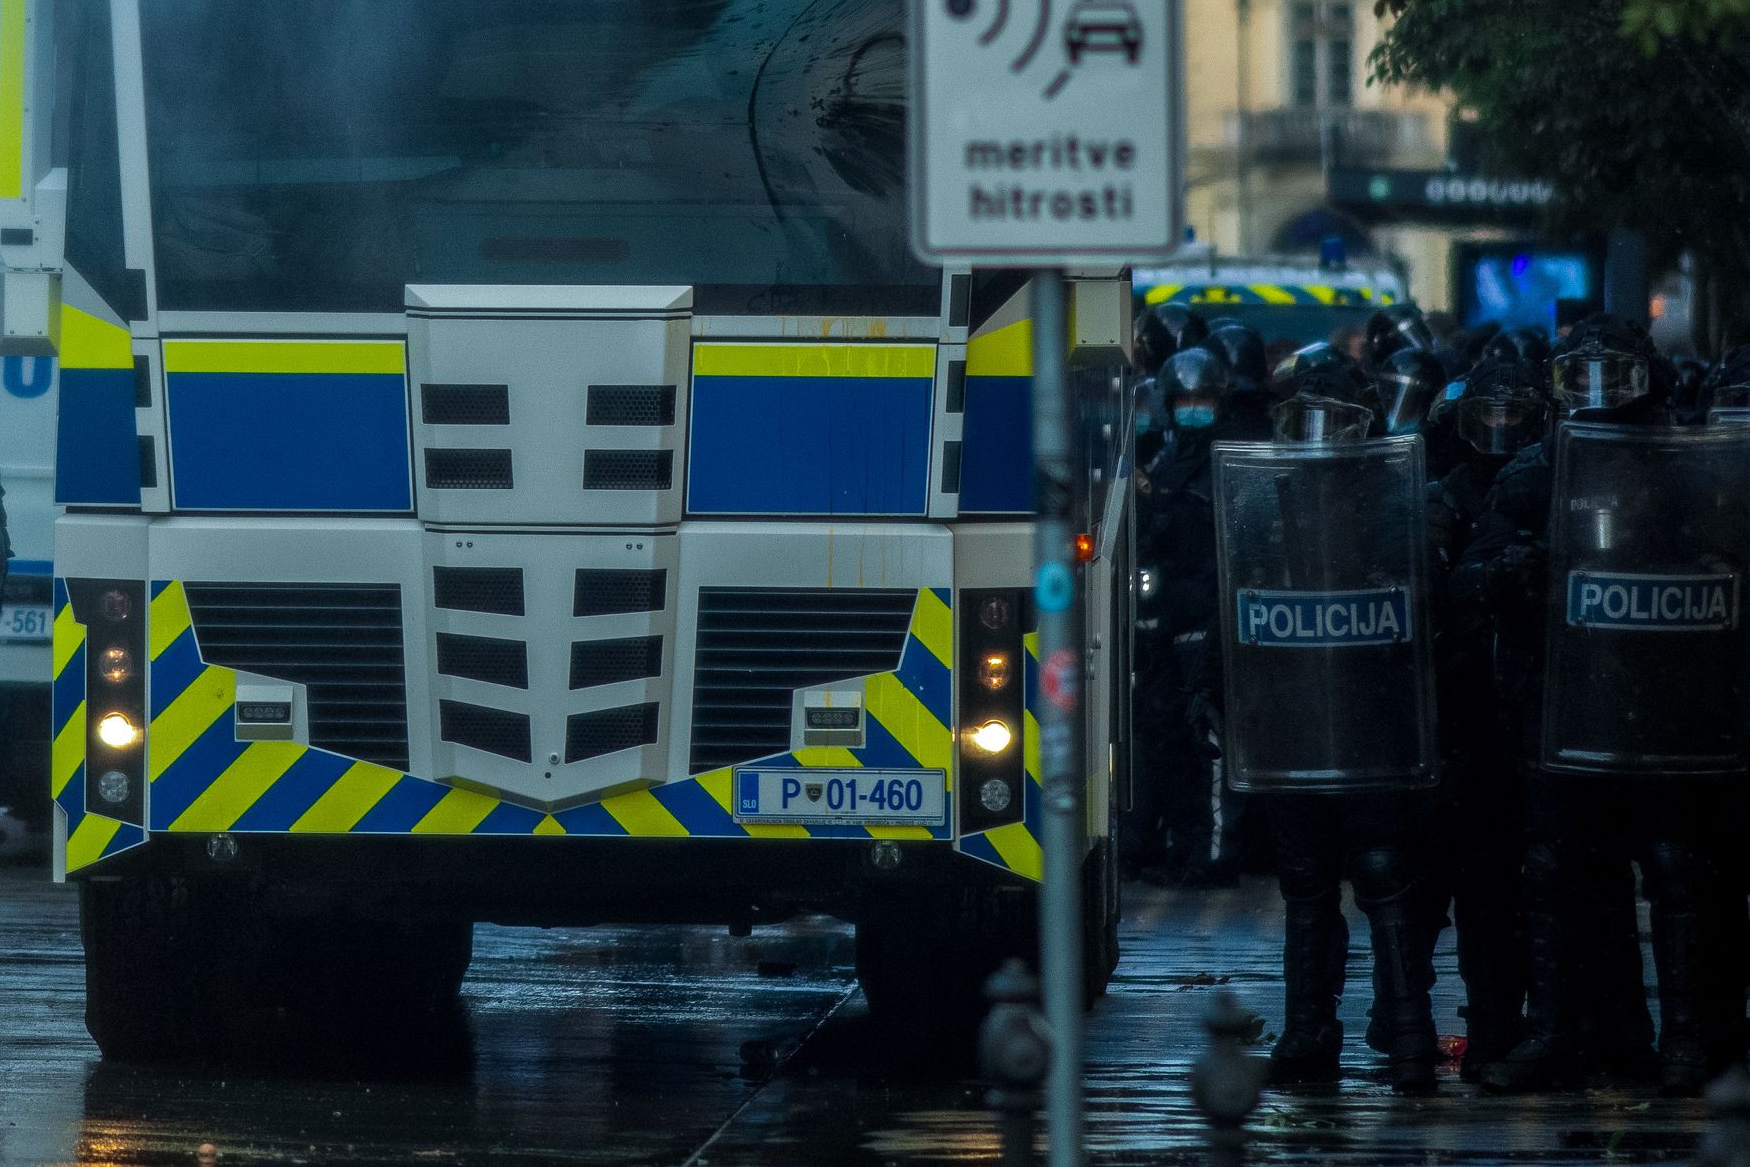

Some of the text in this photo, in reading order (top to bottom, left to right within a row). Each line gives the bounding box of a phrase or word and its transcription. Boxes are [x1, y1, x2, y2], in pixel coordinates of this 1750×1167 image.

[964, 136, 1137, 169] meritve
[968, 186, 1134, 220] hitrosti
[1580, 583, 1727, 620] POLICIJA
[1249, 600, 1401, 638] POLICIJA
[742, 799, 757, 809] SLO
[782, 778, 923, 811] P 01-460
